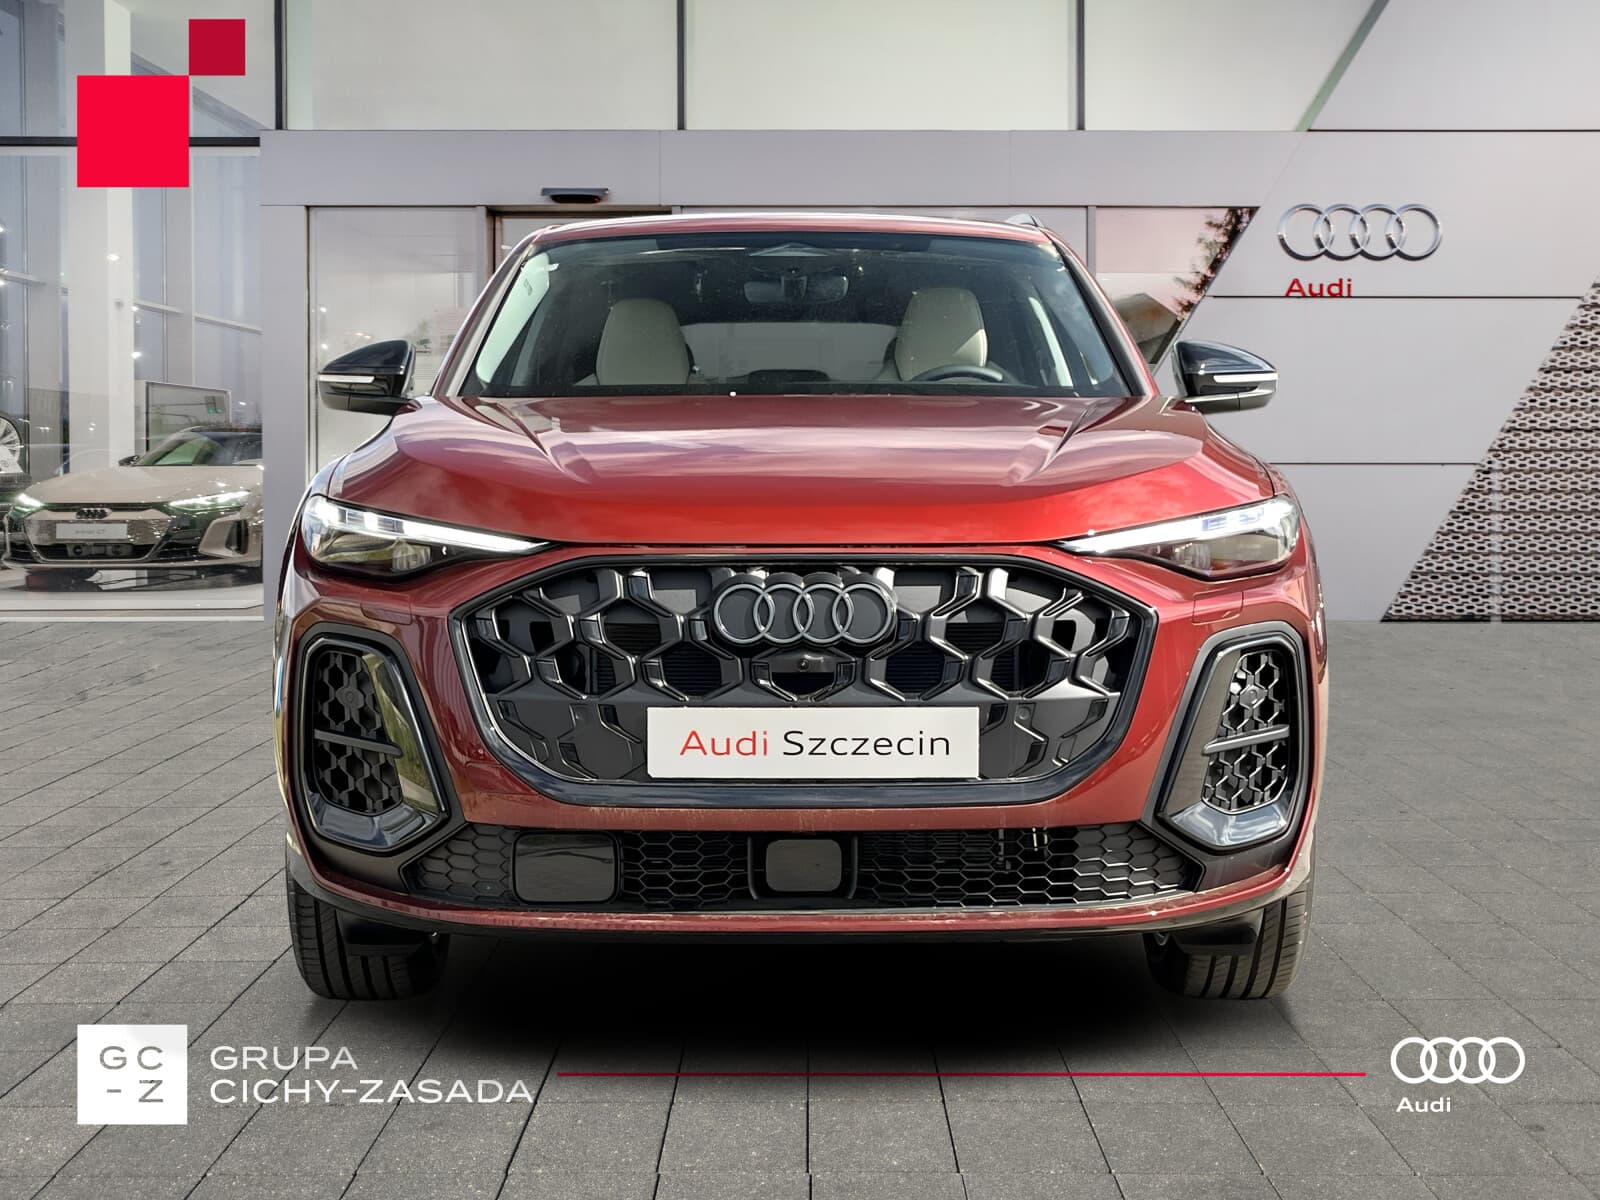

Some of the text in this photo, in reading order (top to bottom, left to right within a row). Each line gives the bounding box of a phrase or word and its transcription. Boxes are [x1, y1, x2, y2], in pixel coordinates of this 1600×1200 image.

[1285, 278, 1352, 297] Audi
[680, 730, 950, 756] Audi Szczecin
